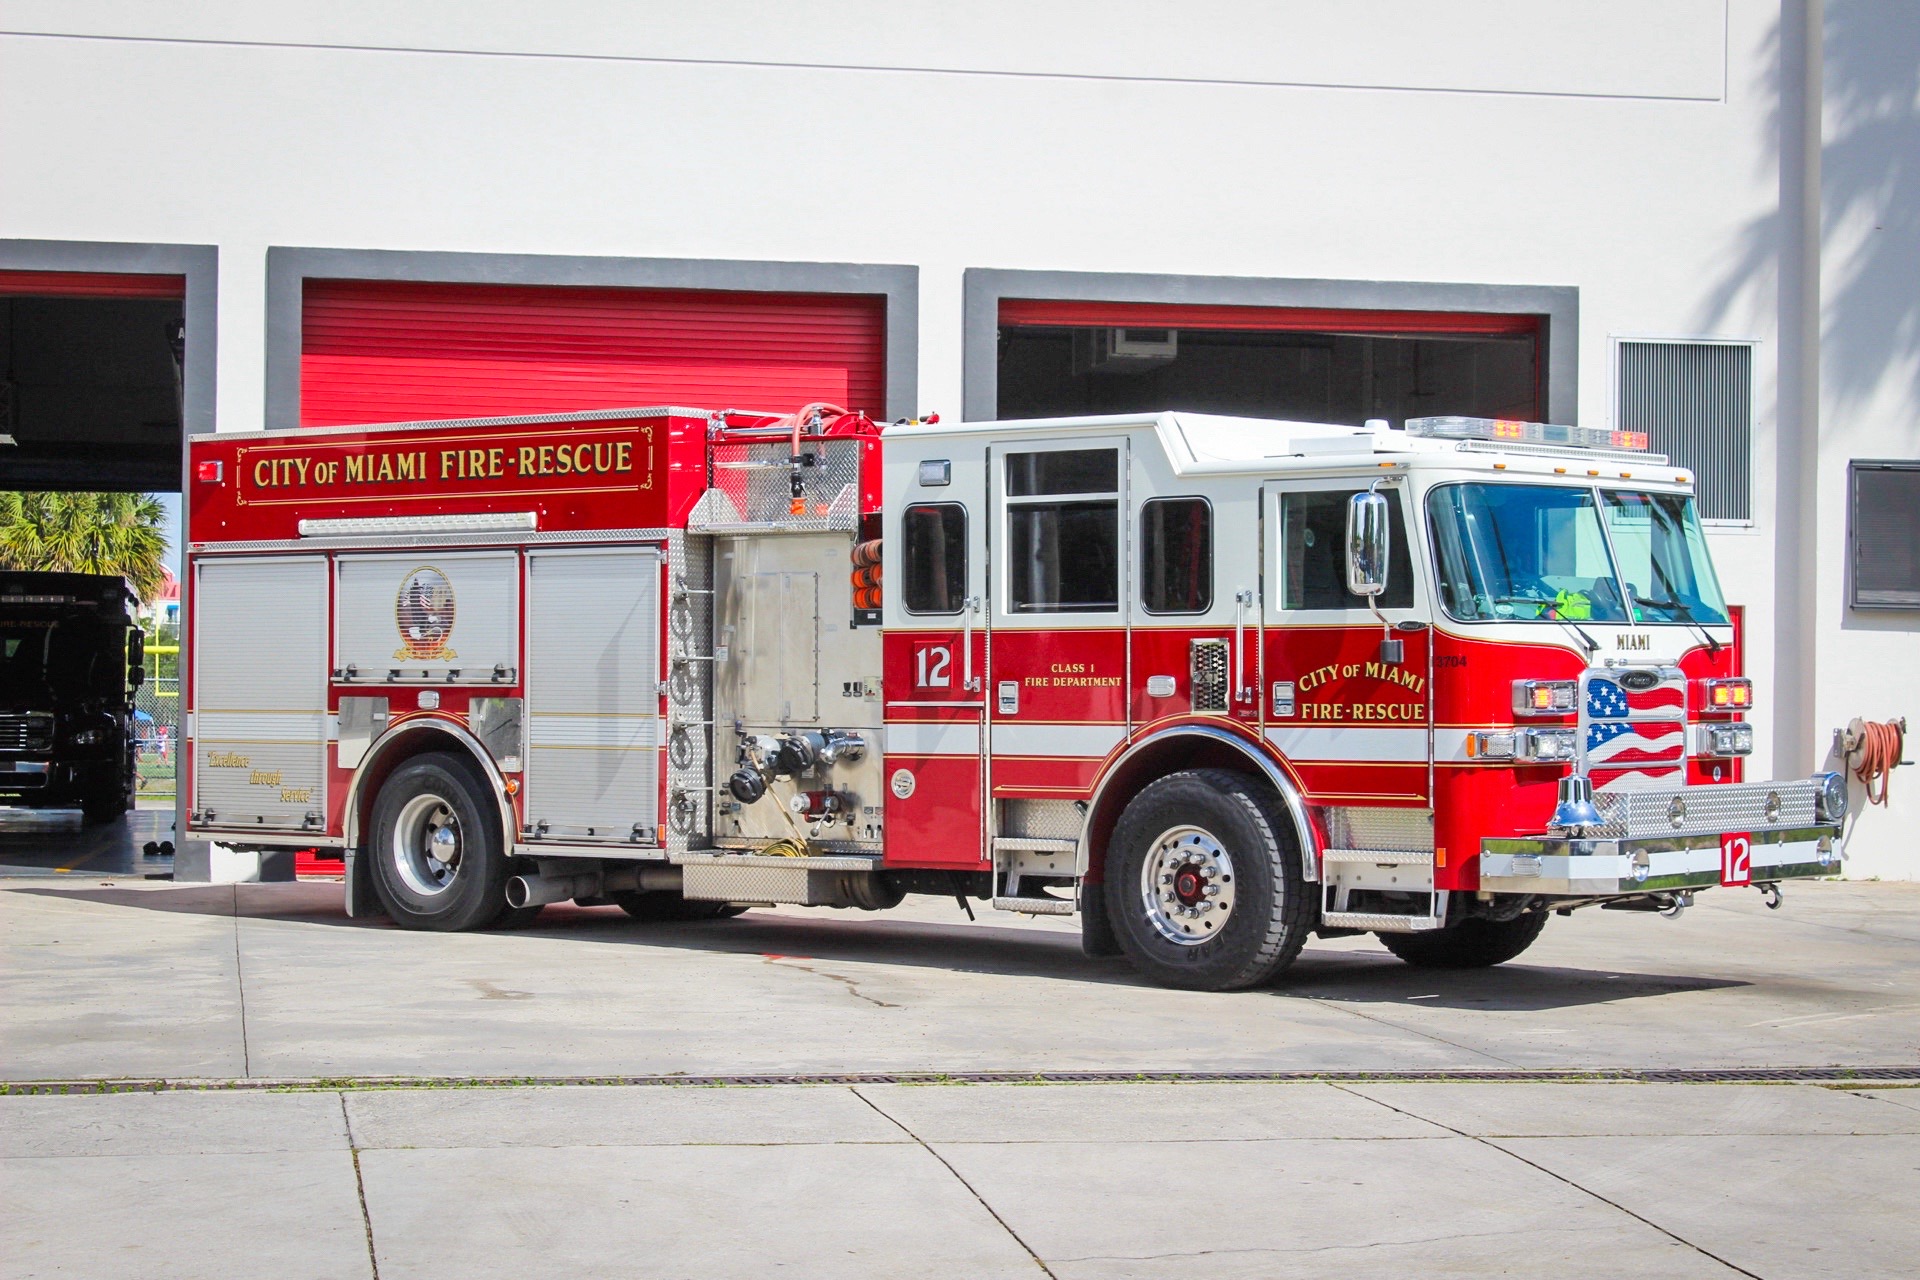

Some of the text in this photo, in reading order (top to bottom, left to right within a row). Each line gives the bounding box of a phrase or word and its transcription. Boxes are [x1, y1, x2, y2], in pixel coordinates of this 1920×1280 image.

[253, 441, 633, 488] CITY OF MIAMI FIRE-RESCUE
[1618, 635, 1650, 649] MIAMI
[916, 647, 951, 687] 12
[1051, 663, 1085, 673] CLASS
[1025, 678, 1122, 688] FIRE DEPARTMENT
[1199, 671, 1217, 682] XT
[1298, 662, 1424, 693] CITY OF MIAMI
[1302, 703, 1425, 720] FIRE-RESCUE
[249, 769, 282, 787] through
[1724, 837, 1749, 882] 12
